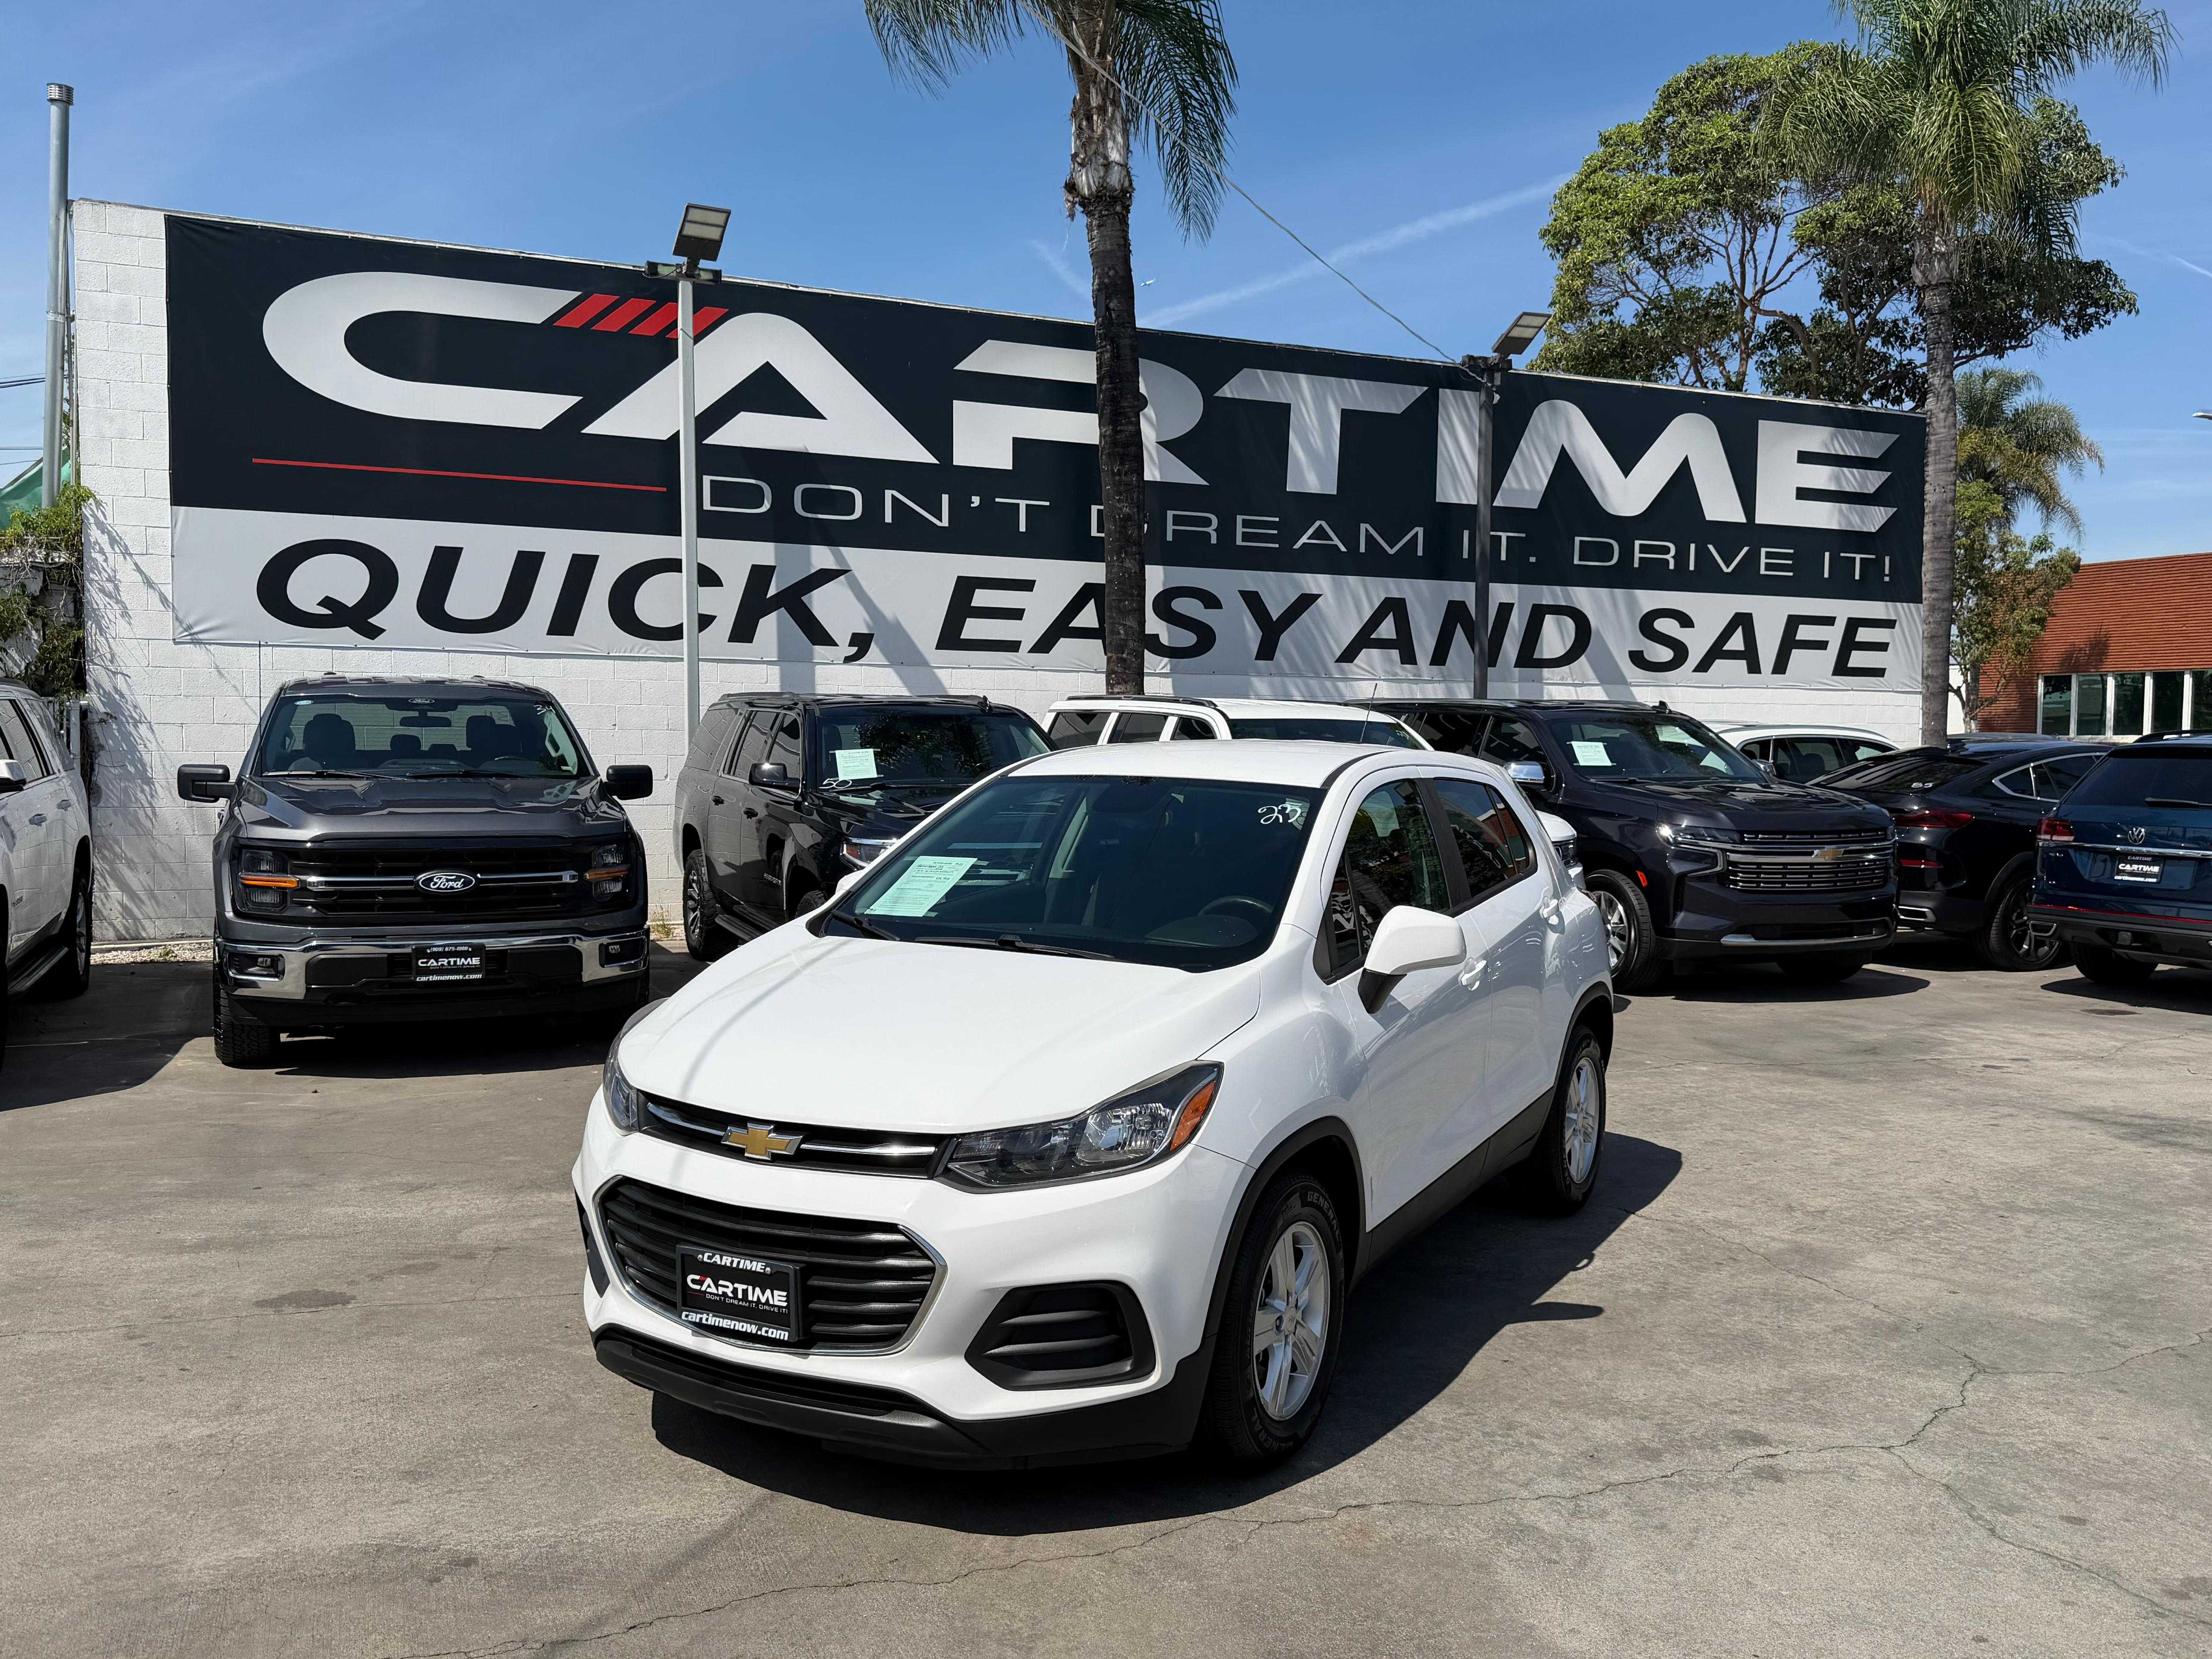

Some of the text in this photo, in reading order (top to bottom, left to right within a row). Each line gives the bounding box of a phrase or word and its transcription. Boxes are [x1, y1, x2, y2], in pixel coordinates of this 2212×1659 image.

[263, 272, 1900, 533] CARTIME
[702, 475, 1050, 532] DON'T
[1462, 529, 1536, 562] IT.
[1573, 536, 1794, 577] DRIVE
[1824, 551, 1891, 582] IT!
[256, 538, 1897, 678] QUICK, EASY AND SAFE
[534, 705, 556, 715] 34
[819, 778, 852, 789] 50
[1257, 803, 1302, 824] 23
[2118, 863, 2160, 872] CARTIME
[430, 875, 465, 889] Ford
[418, 957, 481, 966] CARTIME
[416, 973, 482, 982] cartimenow.com
[1306, 1191, 1341, 1242] GENERAL
[702, 1252, 766, 1273] CARTIME
[686, 1274, 788, 1307] CARTIME
[705, 1293, 724, 1302] DON'T
[726, 1297, 749, 1307] DREAM
[759, 1304, 779, 1313] DRIVE
[681, 1311, 789, 1341] cartimenow.com
